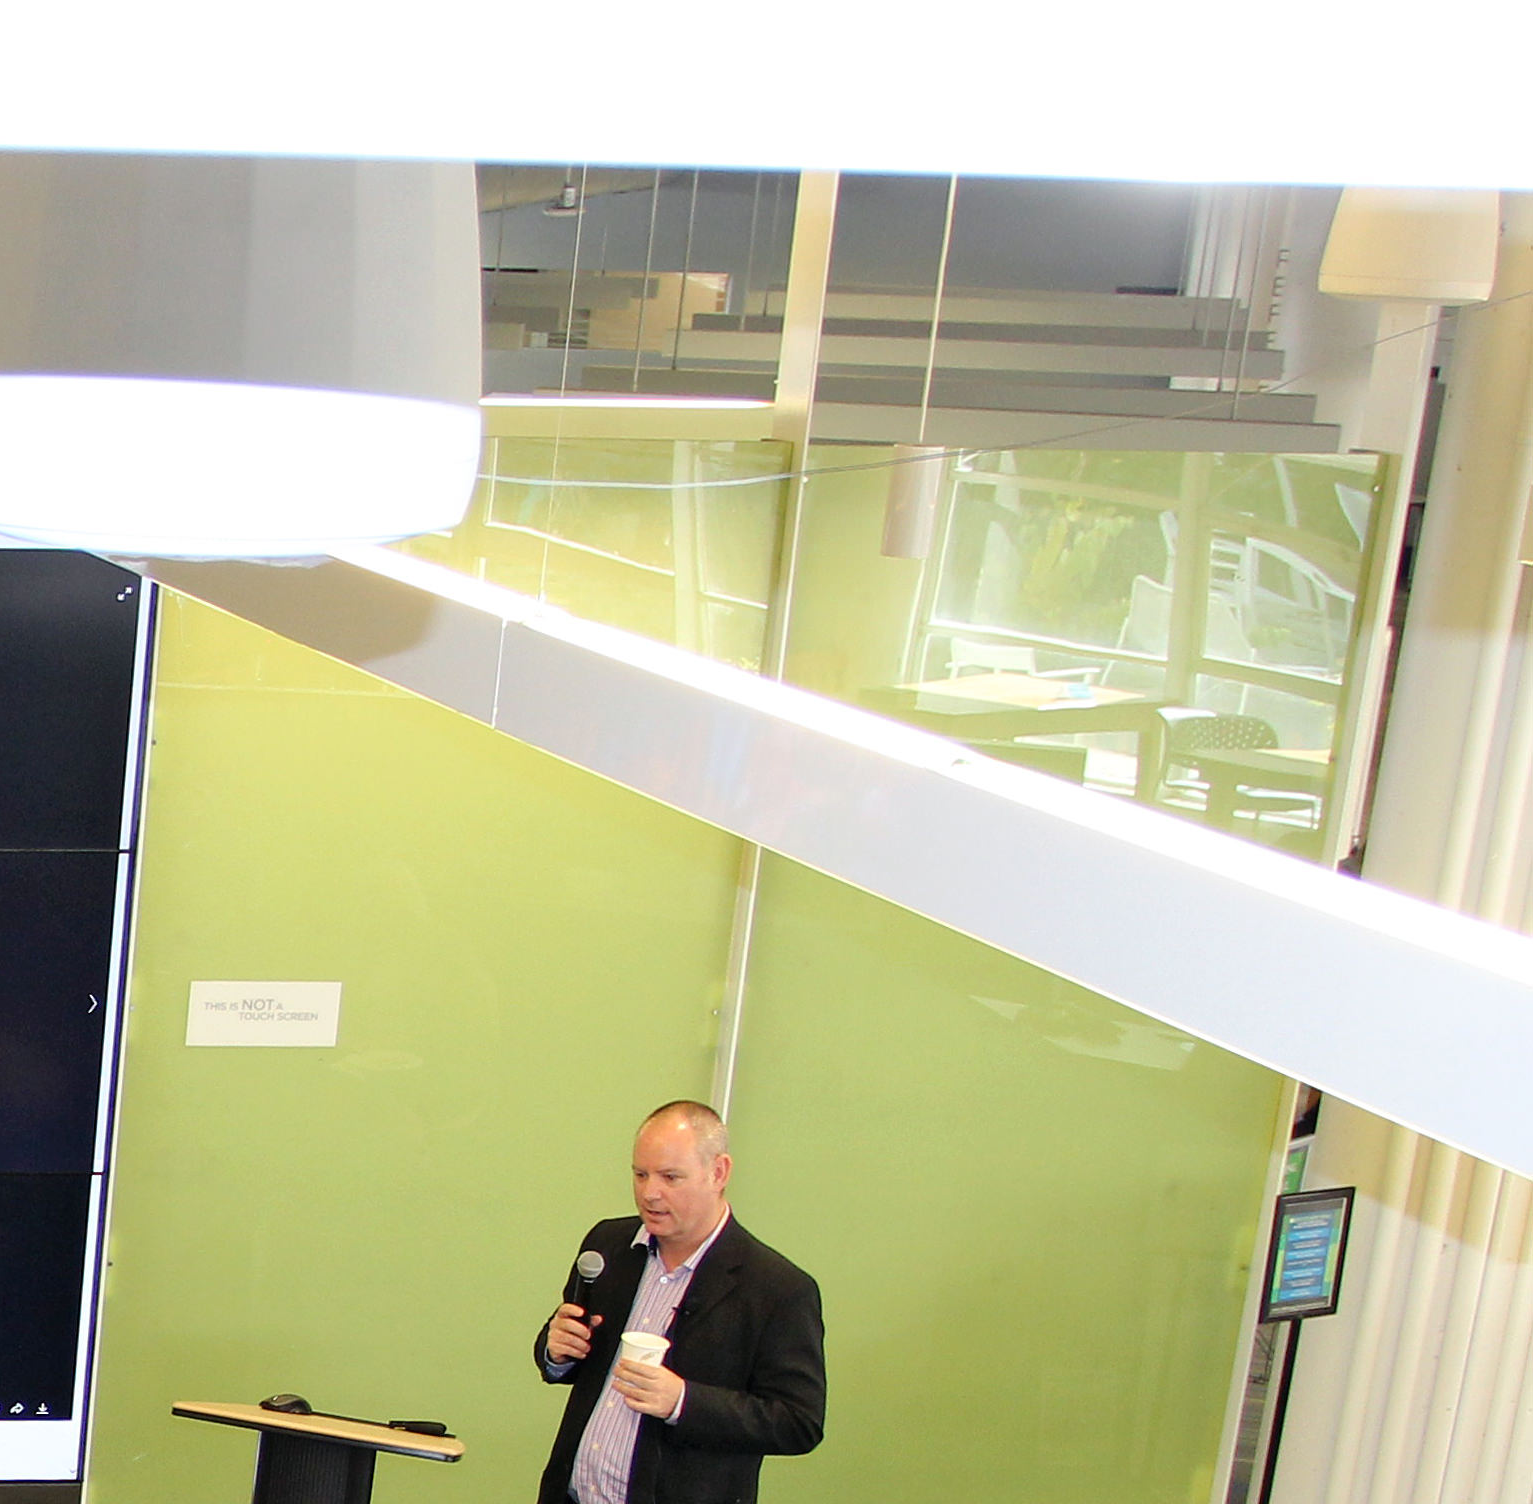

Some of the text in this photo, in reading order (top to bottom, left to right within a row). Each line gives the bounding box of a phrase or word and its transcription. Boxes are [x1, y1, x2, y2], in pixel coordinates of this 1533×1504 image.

[204, 1002, 227, 1011] THIS
[229, 1002, 239, 1011] IS
[241, 999, 275, 1011] NOT
[238, 1012, 319, 1021] TOUCH SCREEN
